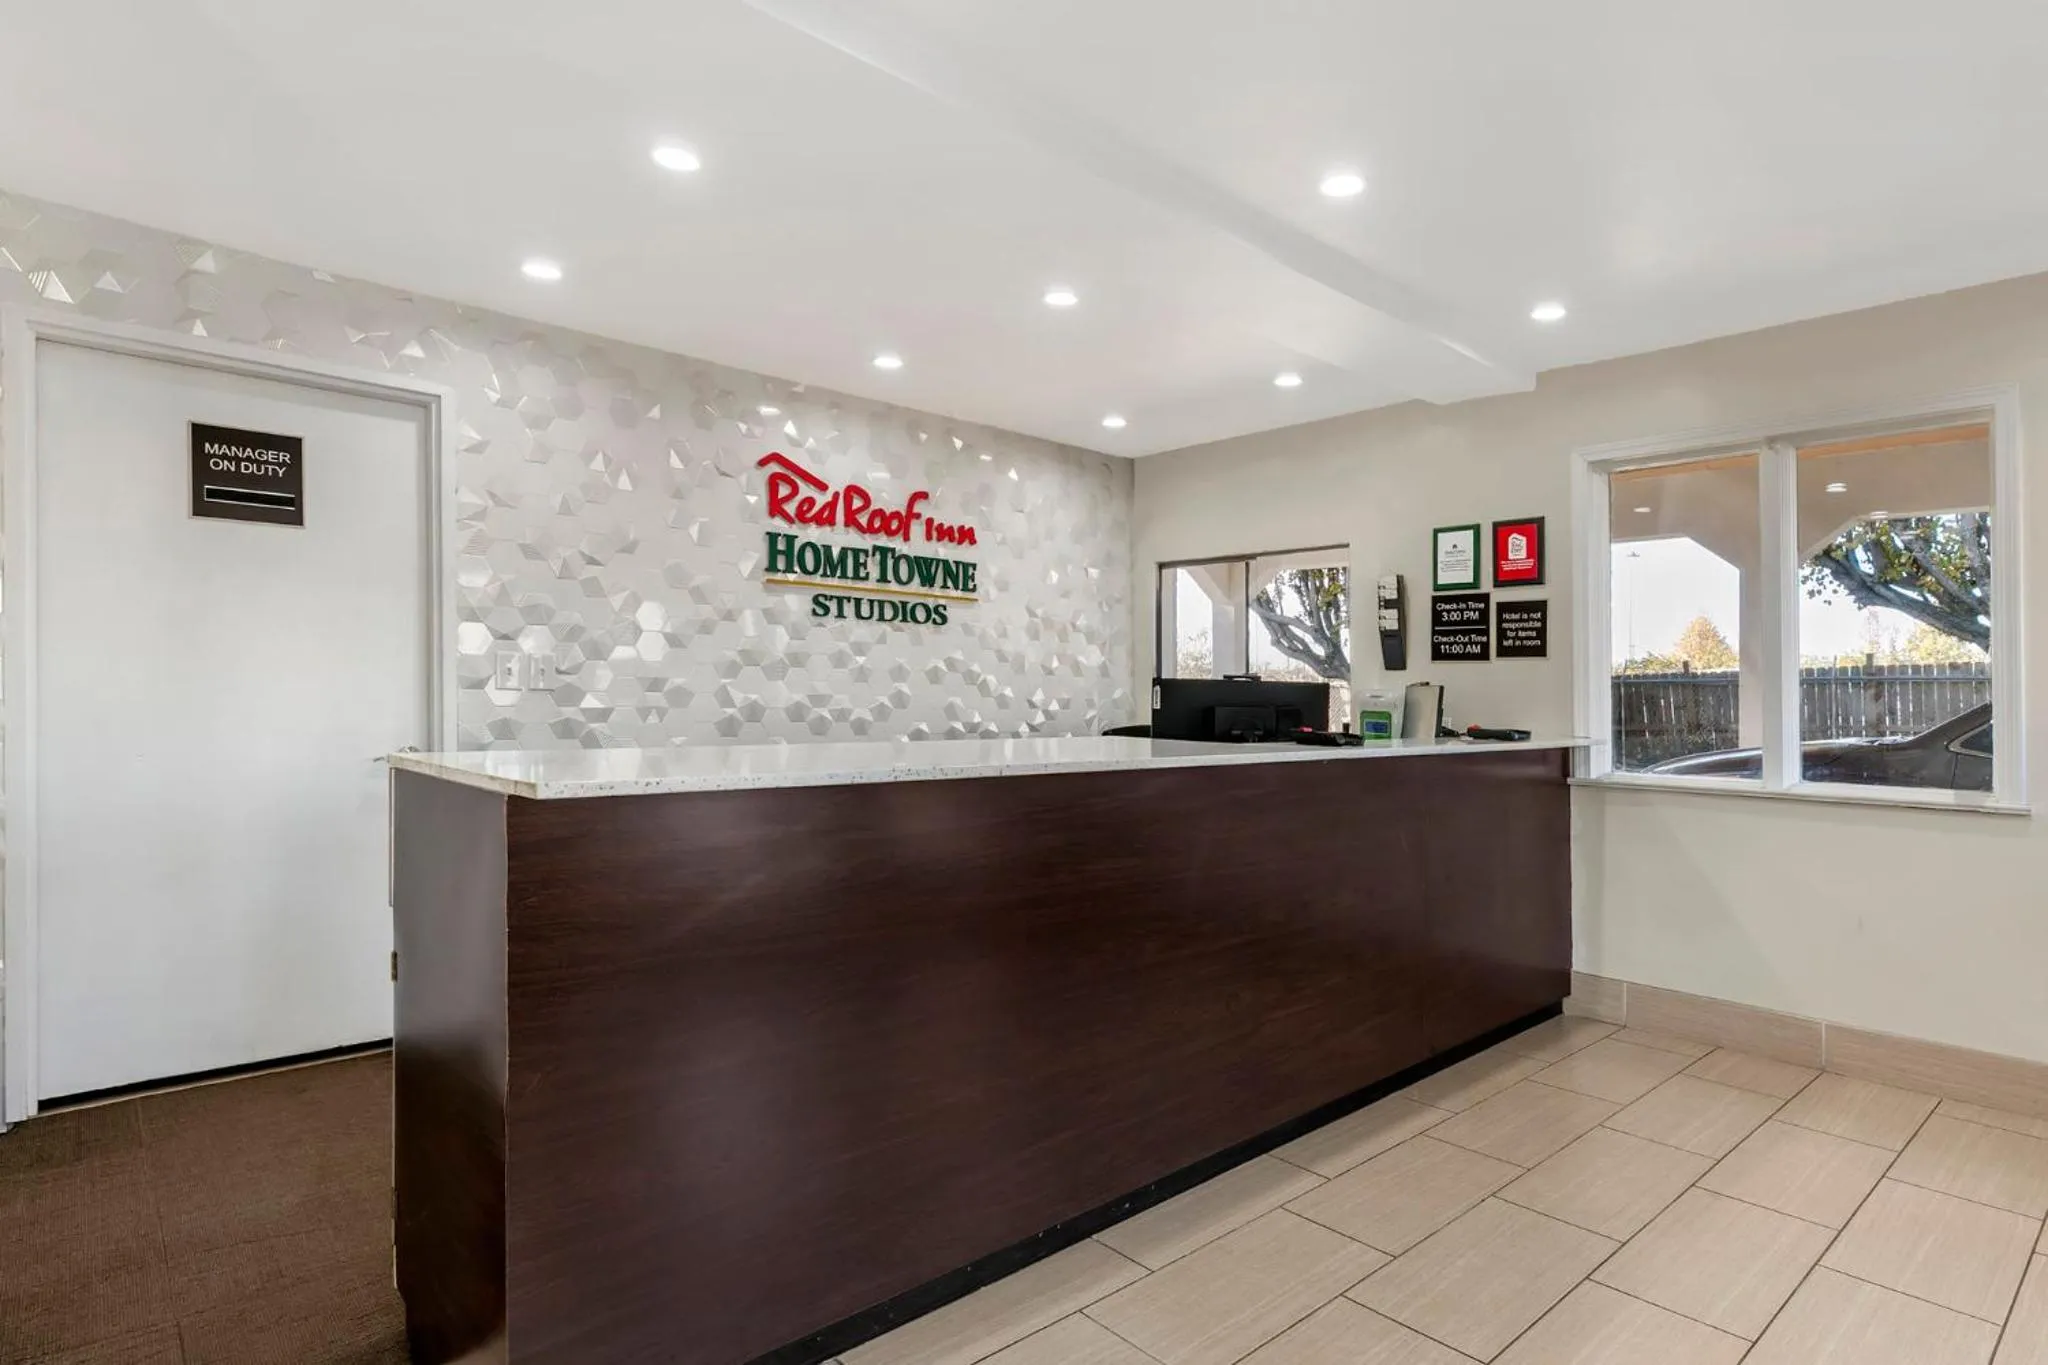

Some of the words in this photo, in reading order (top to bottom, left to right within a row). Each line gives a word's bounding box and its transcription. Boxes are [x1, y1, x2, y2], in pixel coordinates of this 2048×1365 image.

[204, 442, 291, 464] MANAGER
[209, 458, 236, 472] ON
[241, 461, 287, 477] DUTY
[812, 593, 948, 626] STUDIOS
[1468, 601, 1485, 609] Time
[1441, 611, 1461, 621] 3:00
[1463, 611, 1479, 620] PM
[1529, 611, 1541, 619] not
[1501, 621, 1542, 630] responsible
[1433, 634, 1470, 642] Check-Out
[1470, 634, 1487, 642] Time
[1502, 638, 1514, 647] left
[1514, 638, 1522, 646] in
[1522, 639, 1541, 647] room
[1440, 644, 1464, 653] 11:00
[1465, 644, 1481, 654] AM
